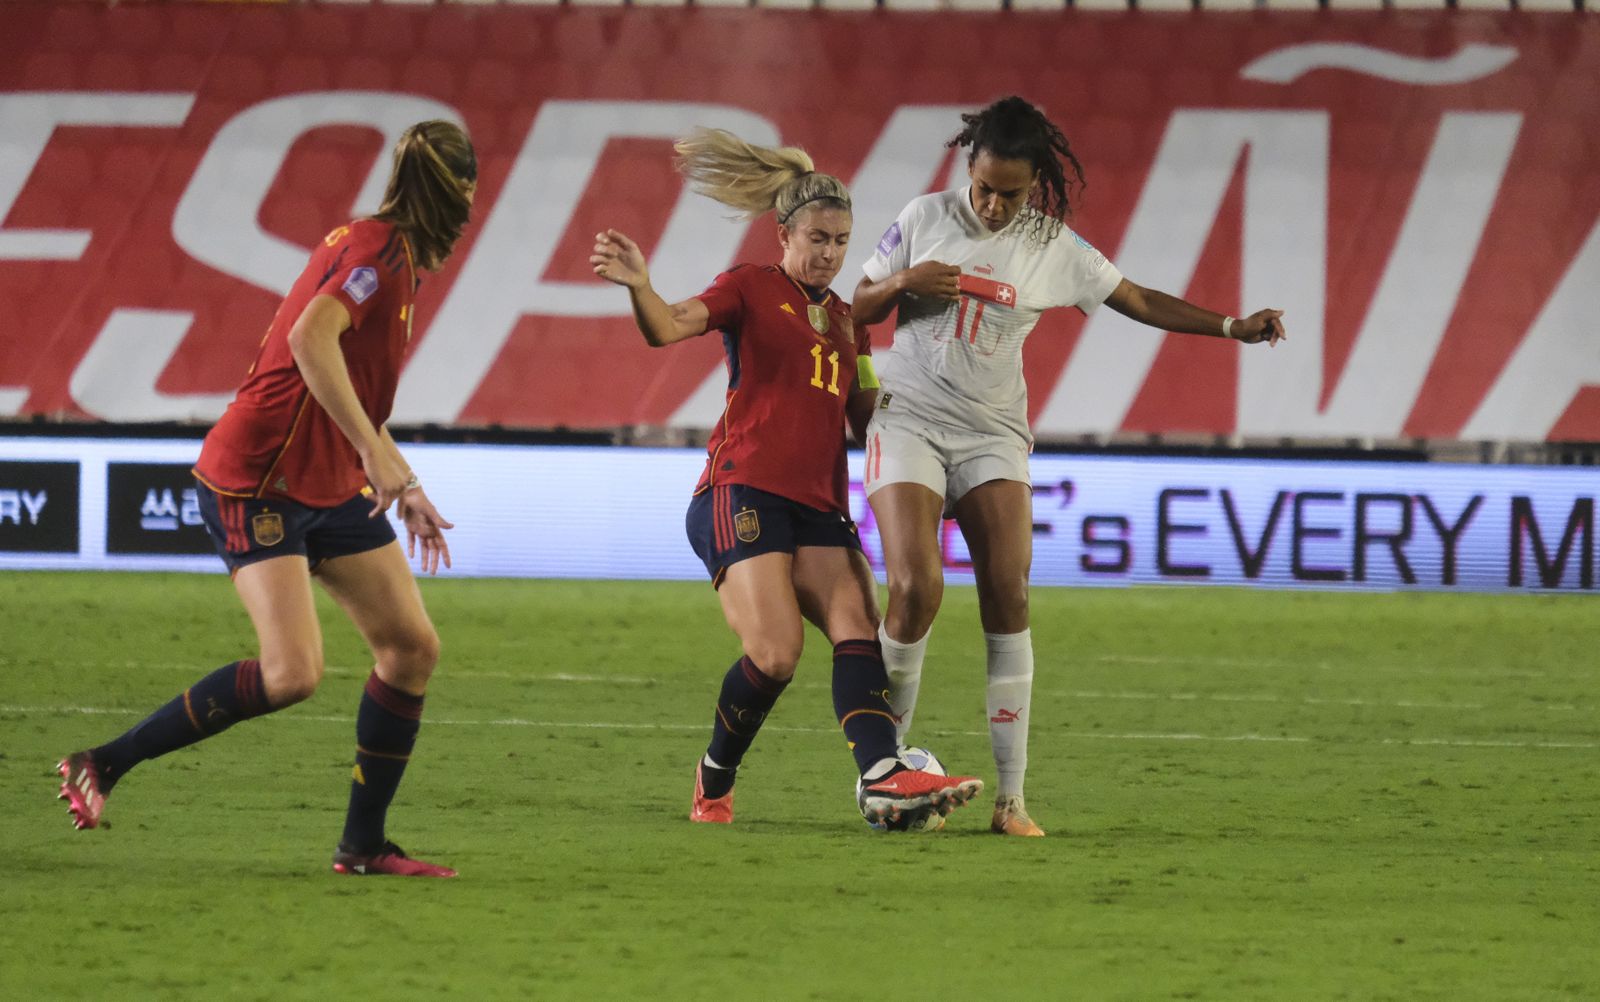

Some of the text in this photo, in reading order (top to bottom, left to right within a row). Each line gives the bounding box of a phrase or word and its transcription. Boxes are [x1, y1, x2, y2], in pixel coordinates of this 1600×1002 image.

[955, 294, 985, 345] 11
[809, 343, 840, 396] 11
[1158, 488, 1486, 585] EVERY
[1509, 496, 1594, 588] M
